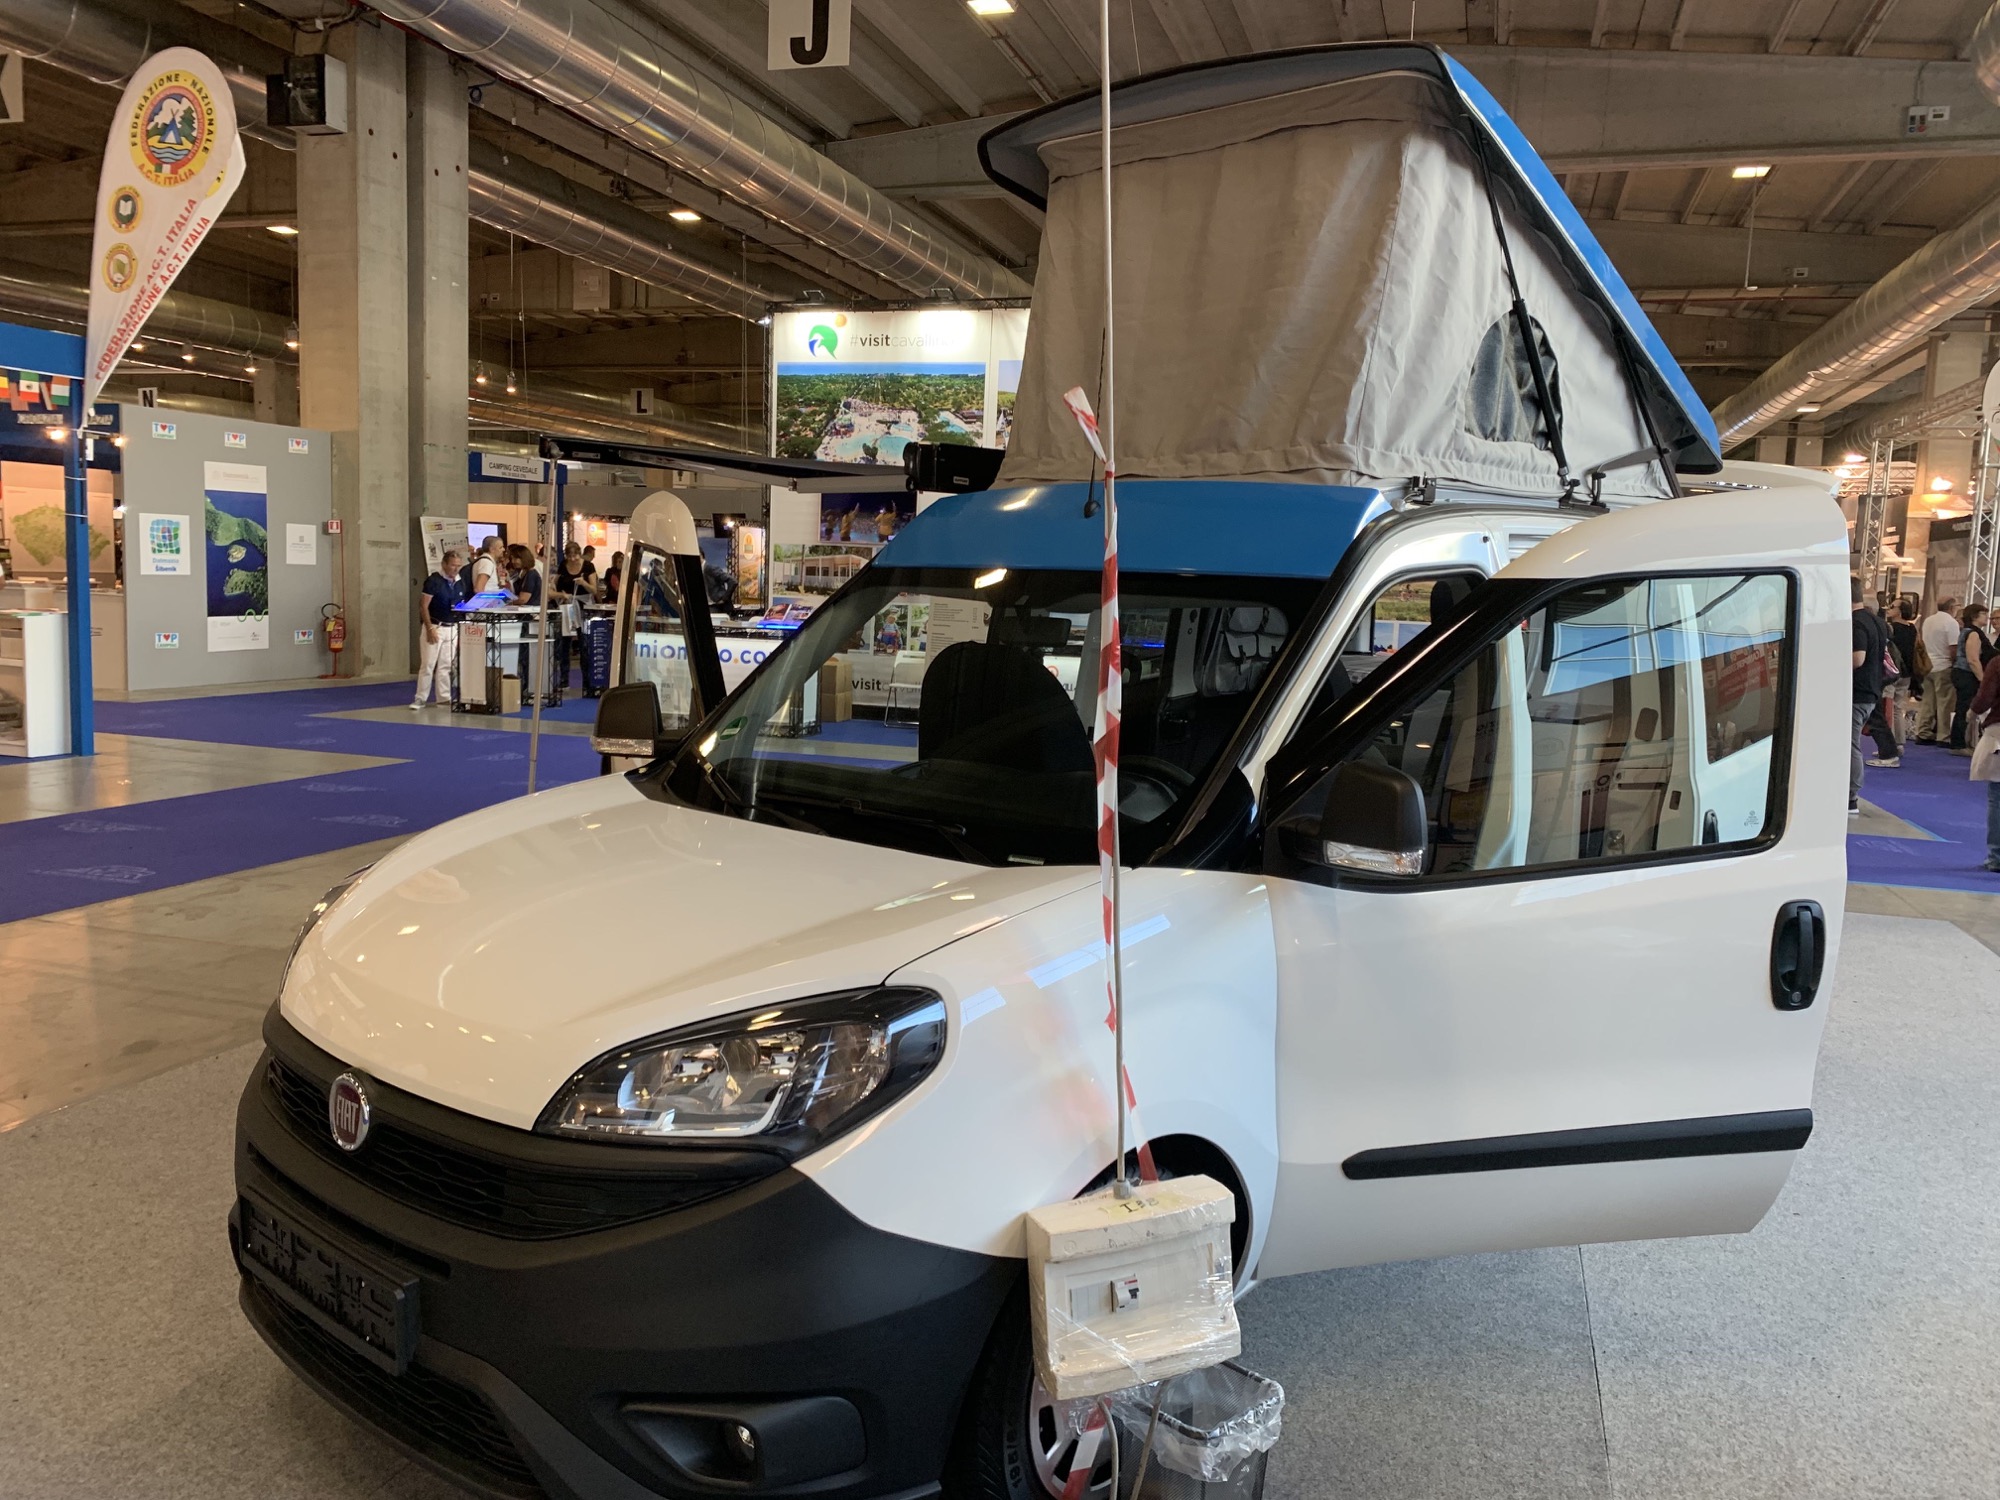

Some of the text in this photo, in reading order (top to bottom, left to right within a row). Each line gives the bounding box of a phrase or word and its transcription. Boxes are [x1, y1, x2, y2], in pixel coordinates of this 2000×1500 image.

[790, 0, 829, 65] J
[131, 73, 214, 154] FEDERAZIONE NAZIONALE
[163, 168, 195, 185] ITALIA
[166, 198, 197, 243] ITALIA
[160, 253, 185, 285] A.C.T.
[181, 216, 210, 252] ITALIA
[142, 390, 153, 408] N
[636, 390, 647, 413] L
[489, 462, 513, 473] CAMPING
[336, 1094, 359, 1135] FIAT
